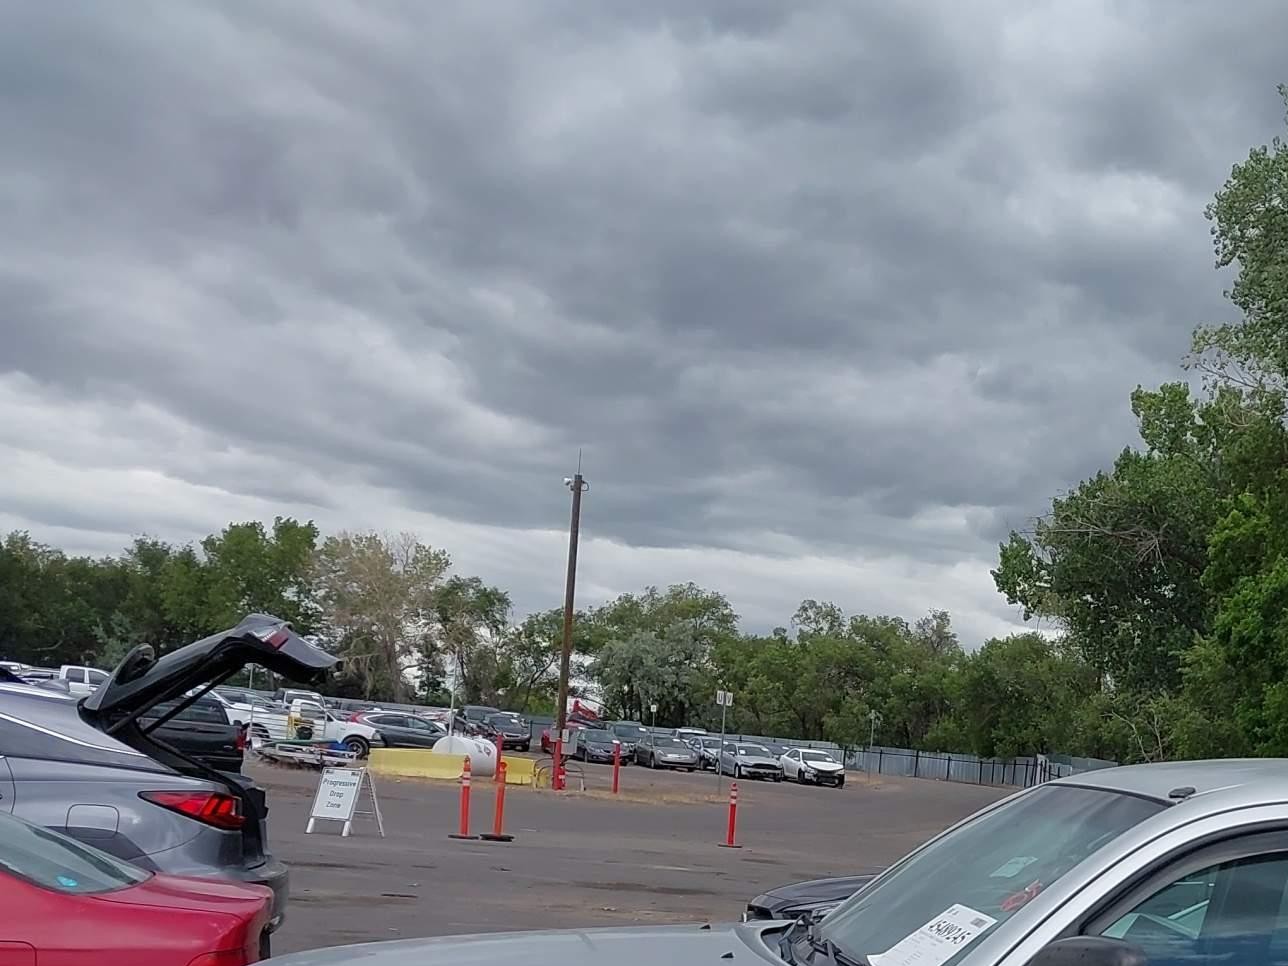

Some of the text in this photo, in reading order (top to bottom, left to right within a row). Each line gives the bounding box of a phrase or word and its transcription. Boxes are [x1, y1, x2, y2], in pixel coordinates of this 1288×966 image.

[323, 778, 357, 788] Progressive
[329, 790, 344, 799] Drop
[326, 801, 341, 809] Zone
[928, 919, 972, 945] 45489245
